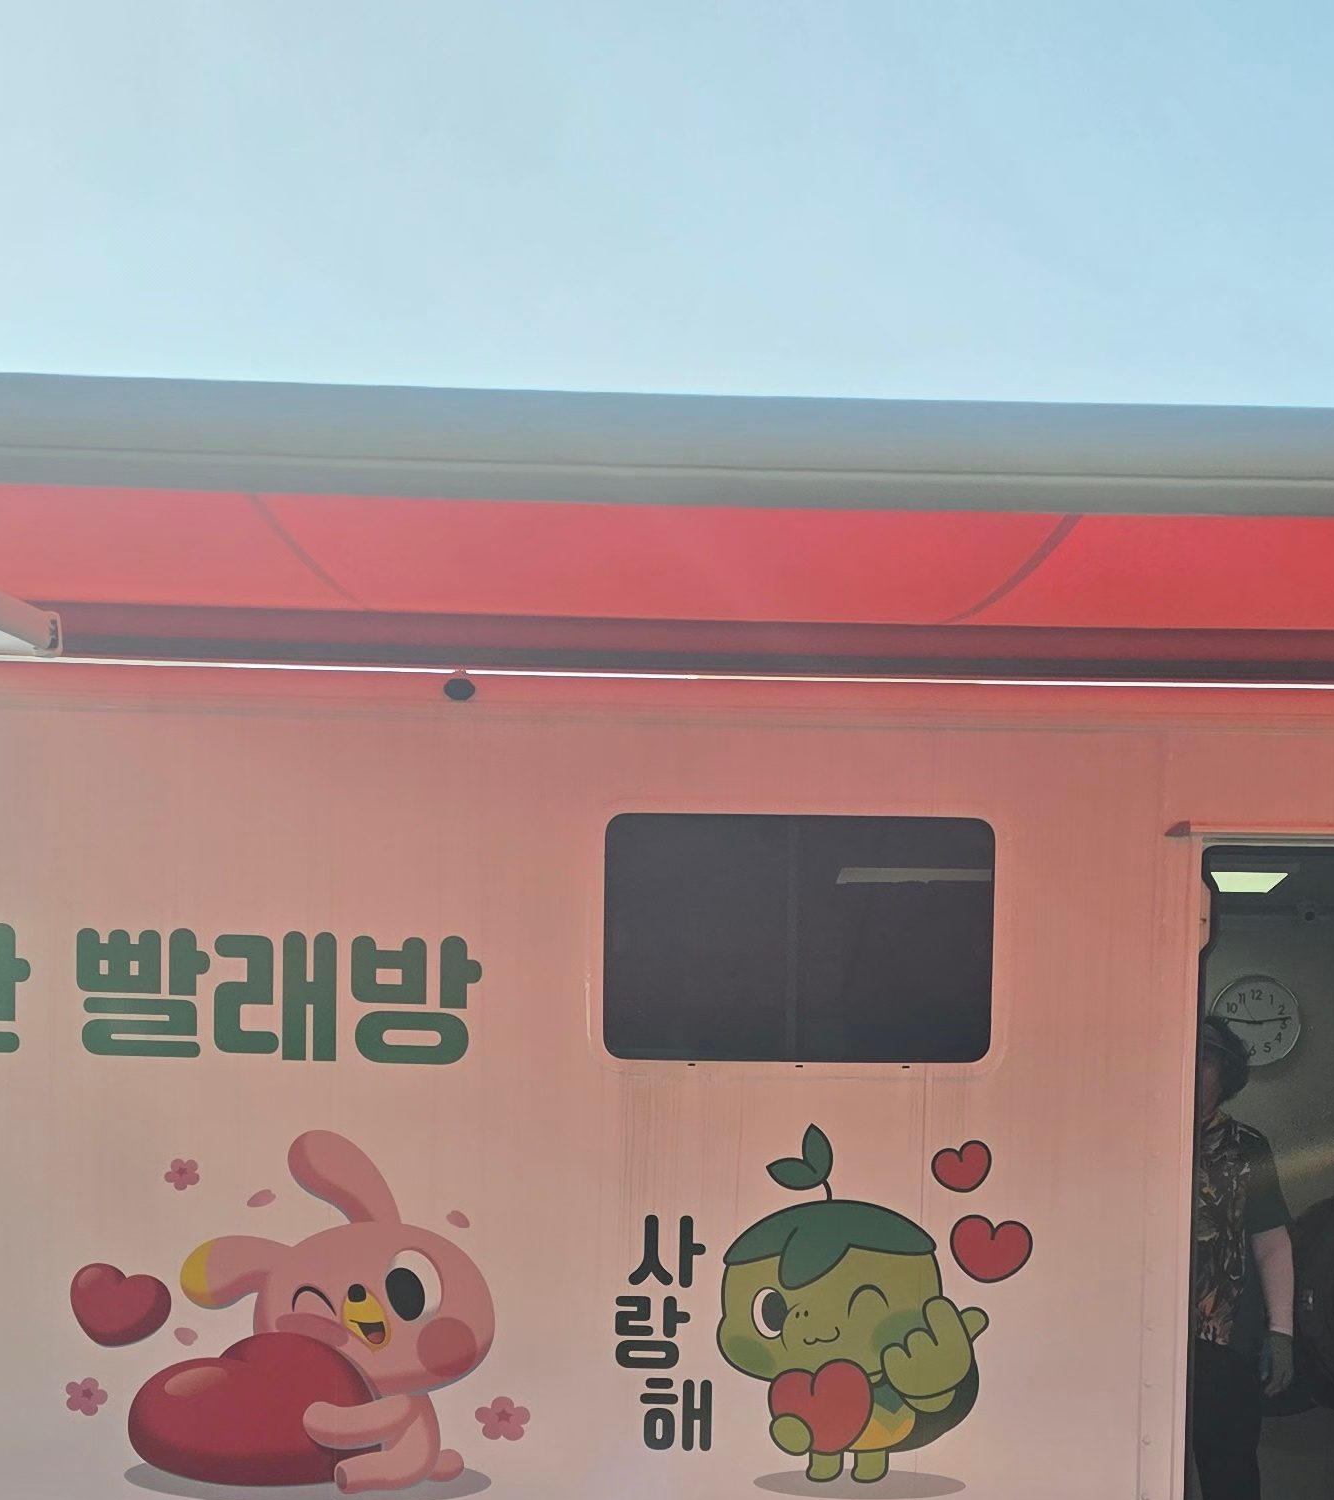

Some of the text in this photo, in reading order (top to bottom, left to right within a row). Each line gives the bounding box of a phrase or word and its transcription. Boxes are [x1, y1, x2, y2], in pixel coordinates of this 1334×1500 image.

[76, 927, 483, 1066] 빨래방
[1238, 992, 1246, 1004] 11
[1250, 989, 1263, 1001] 12
[1227, 1002, 1238, 1014] 10
[1278, 1005, 1285, 1016] 2
[1275, 1031, 1282, 1044] 4
[1263, 1042, 1272, 1053] 5
[614, 1214, 713, 1452] 사랑해
